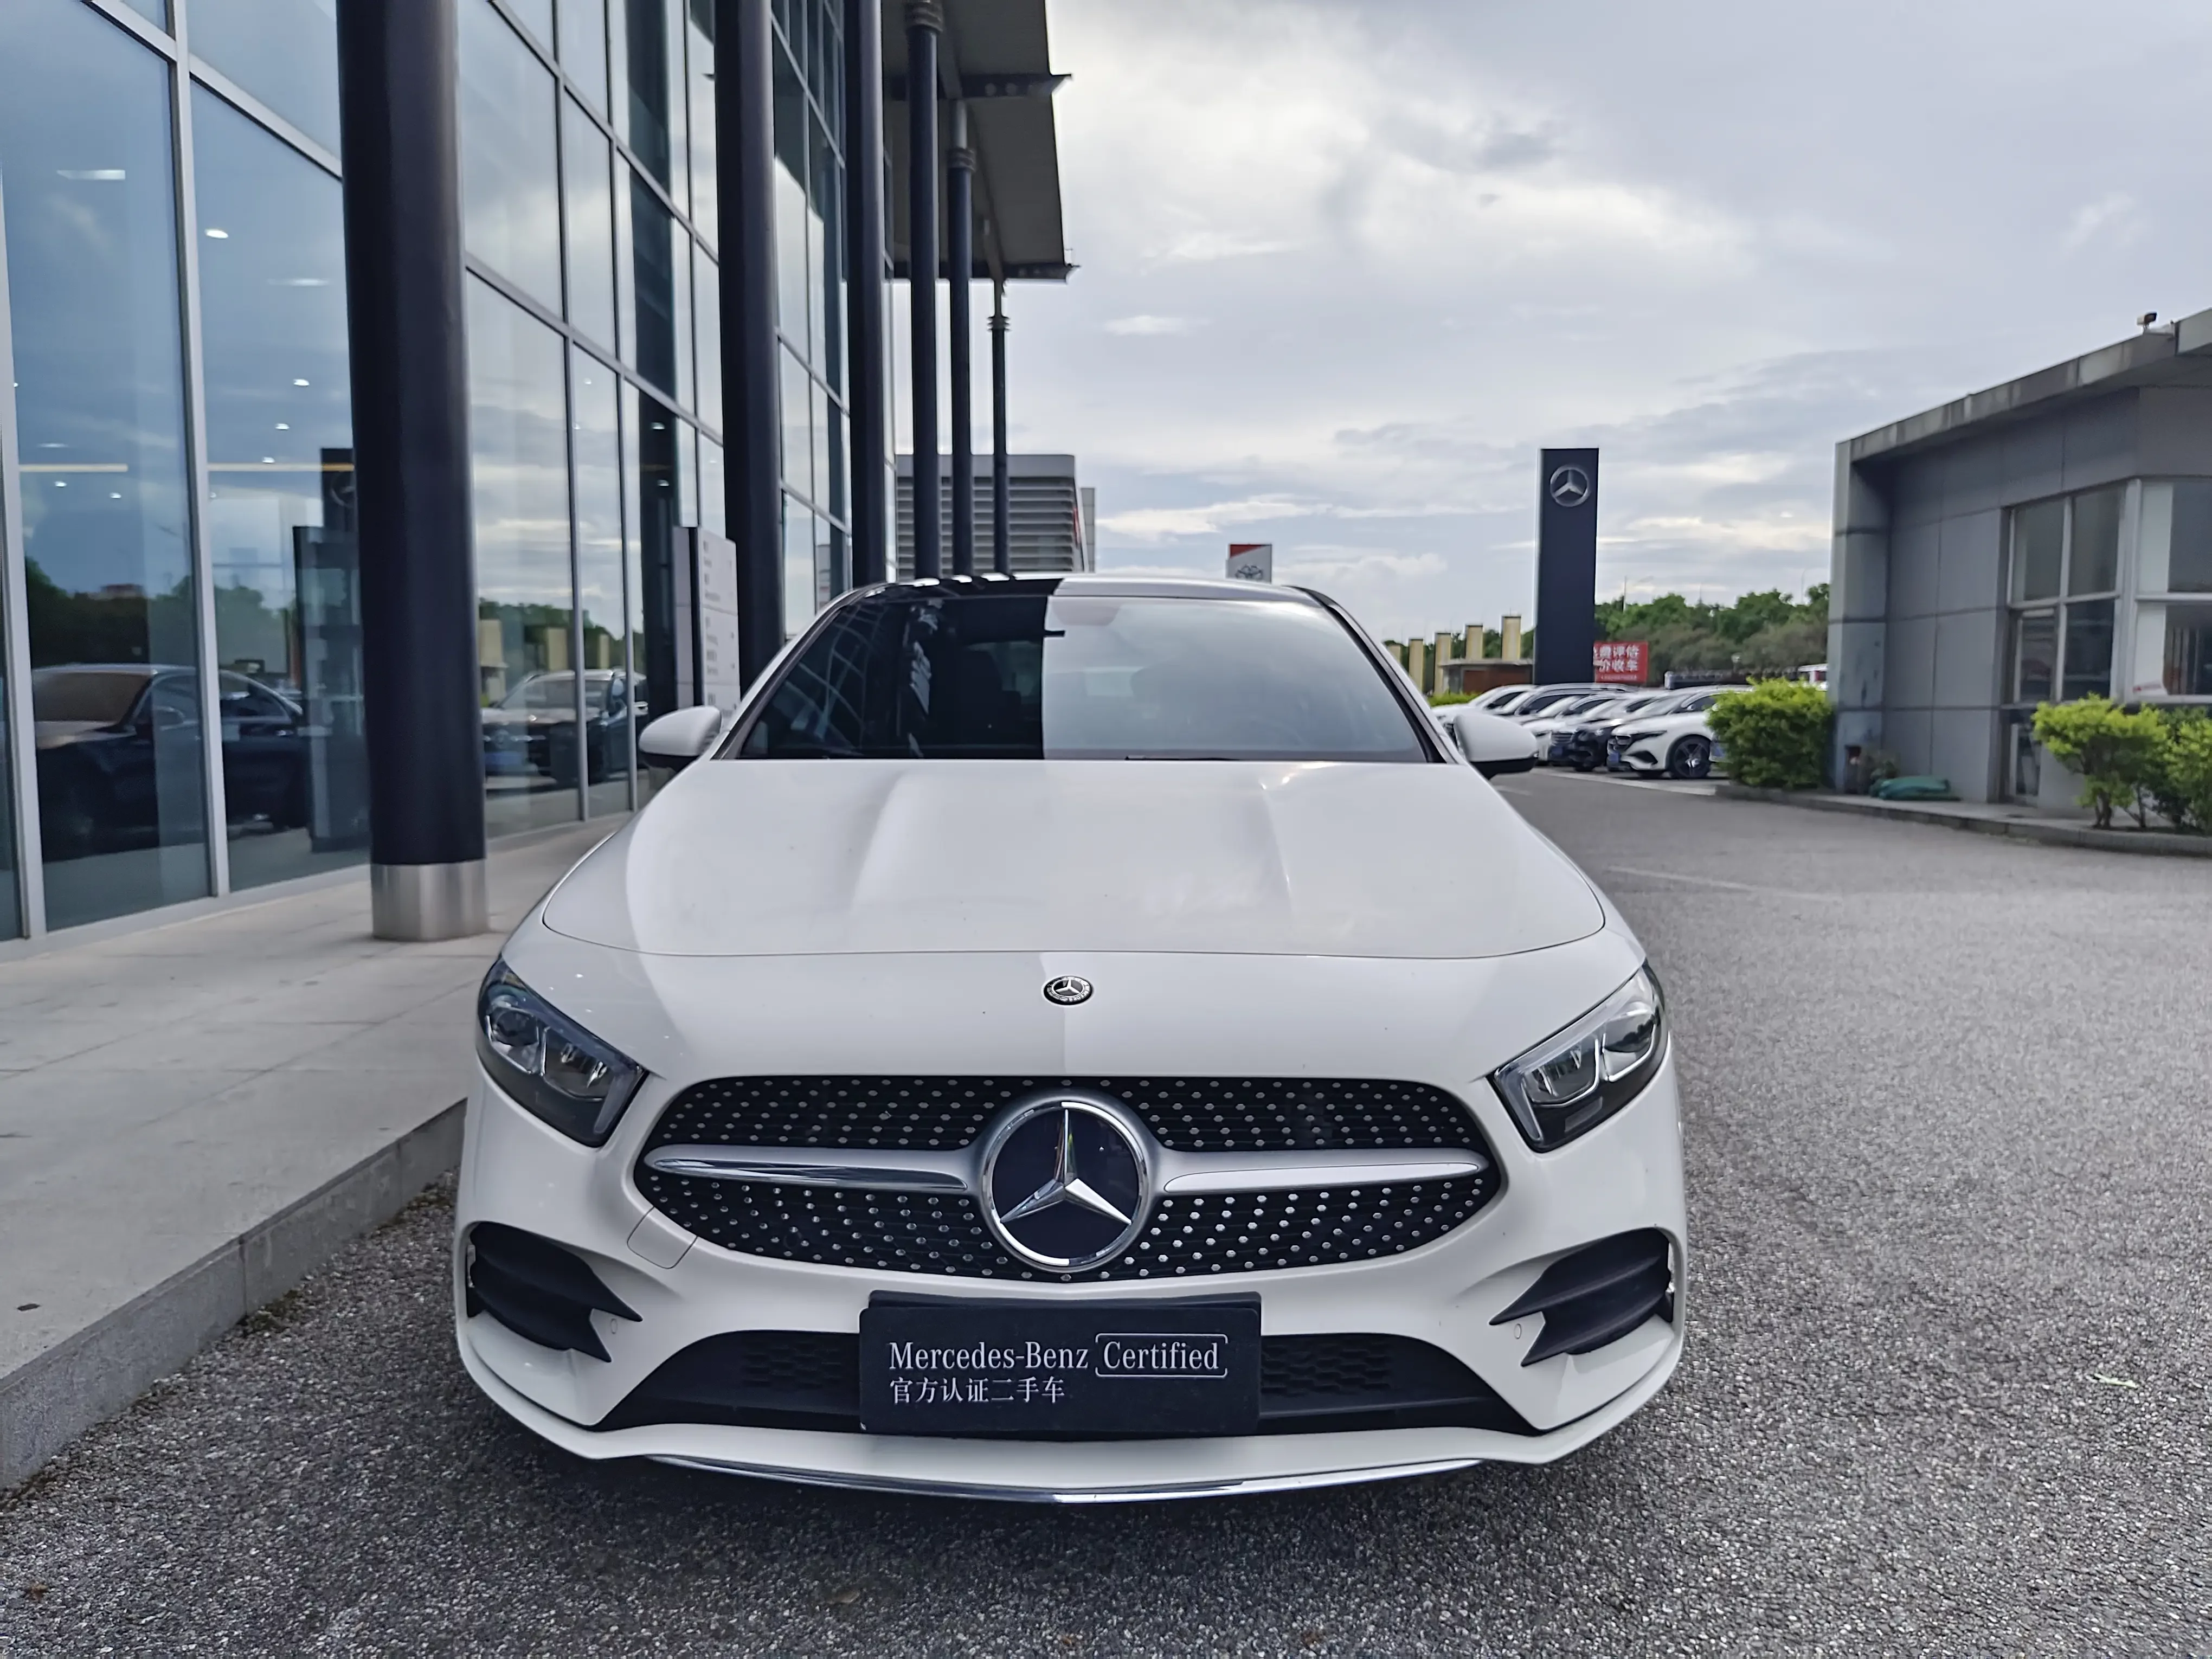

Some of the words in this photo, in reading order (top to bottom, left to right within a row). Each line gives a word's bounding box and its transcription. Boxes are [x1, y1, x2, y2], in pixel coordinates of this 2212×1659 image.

[1593, 658, 1638, 672] 价收车
[889, 1341, 1088, 1369] Mercedes-Benz
[1104, 1341, 1219, 1369] Certified
[890, 1376, 1065, 1405] 官方认证二手车
